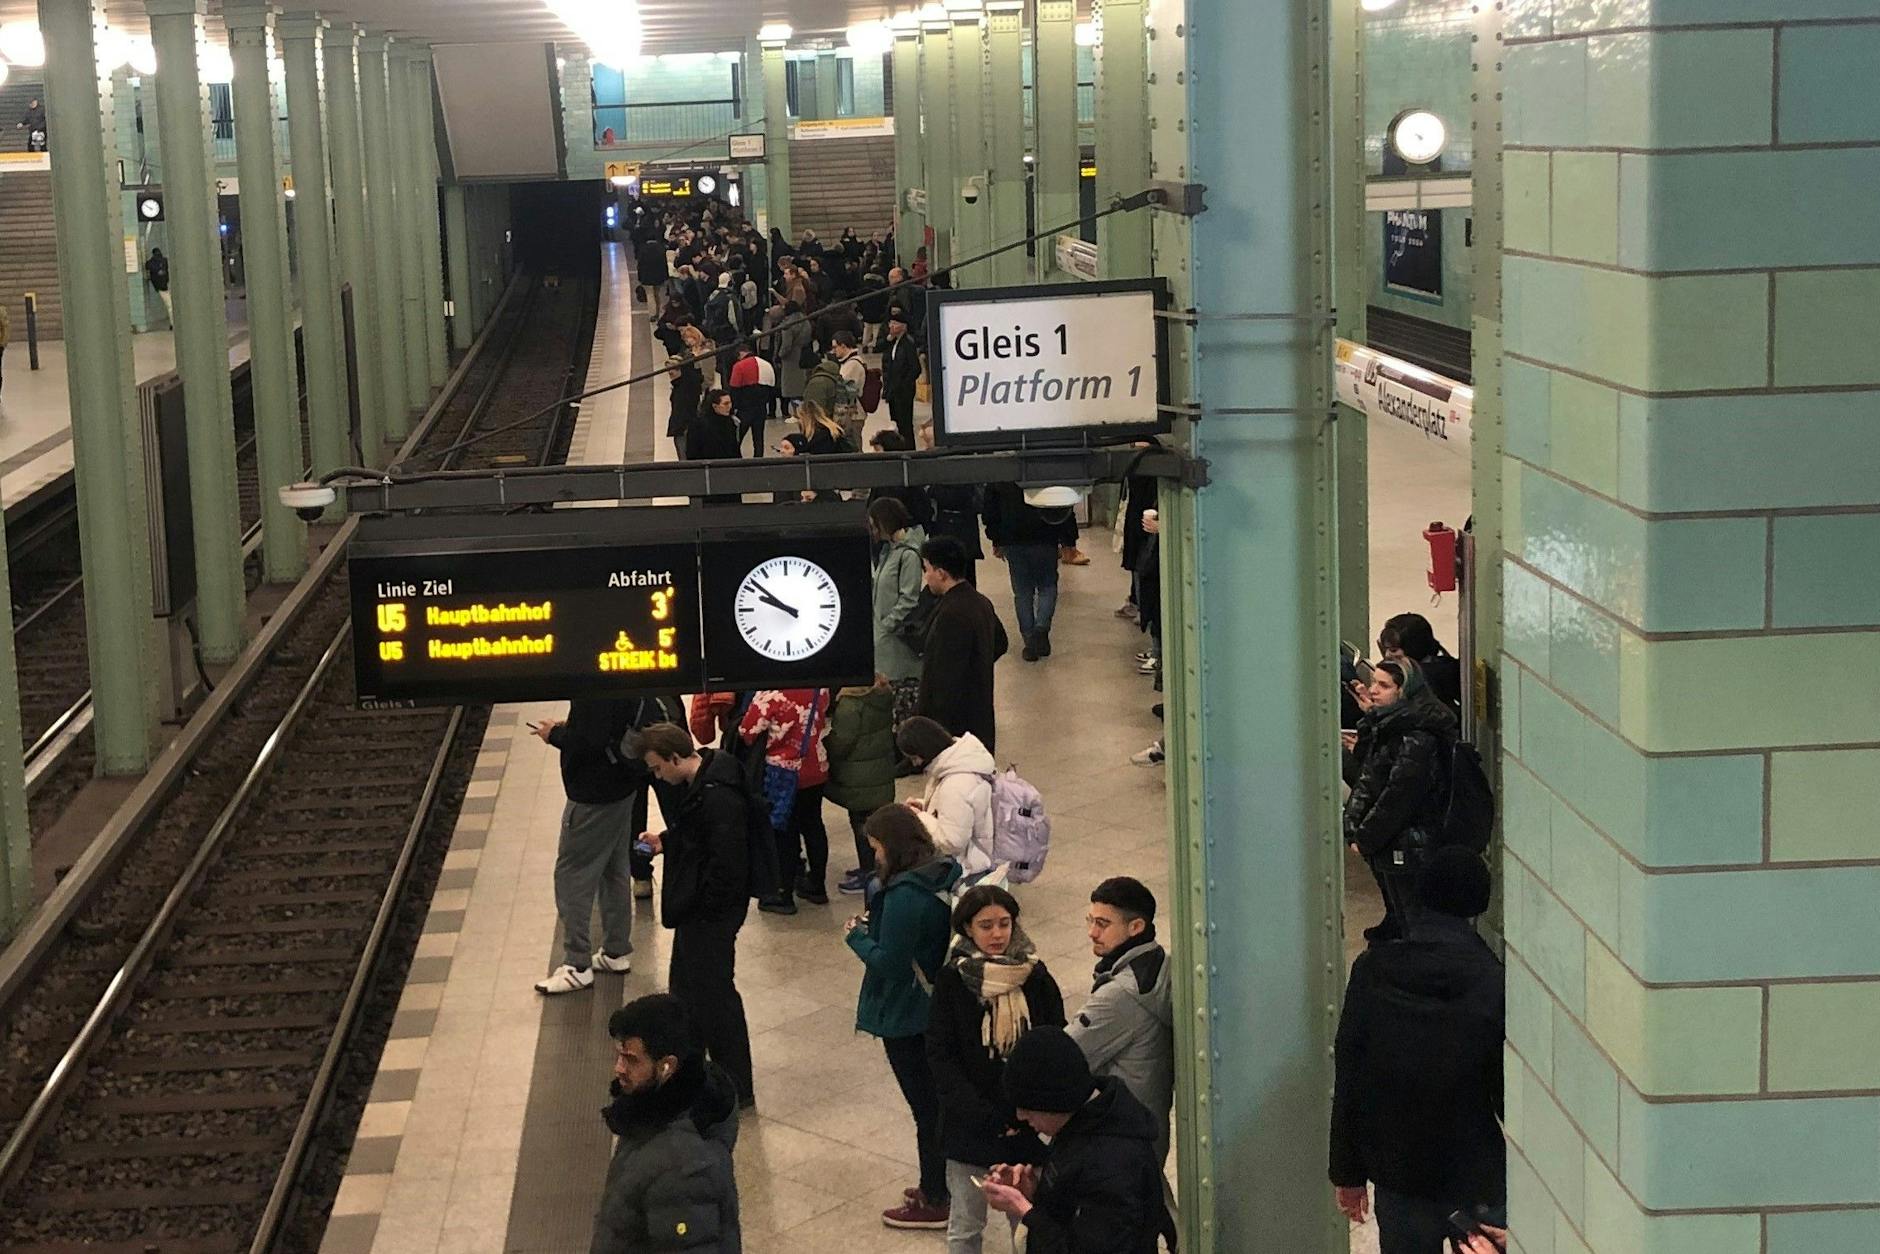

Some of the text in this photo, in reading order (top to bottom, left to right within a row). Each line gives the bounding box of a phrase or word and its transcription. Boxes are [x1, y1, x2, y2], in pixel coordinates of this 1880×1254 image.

[954, 323, 1067, 361] Gleis 1
[957, 365, 1142, 407] Platform 1
[377, 579, 453, 598] Linie Ziel
[607, 569, 672, 588] Abfahrt
[376, 601, 552, 632] U5 Hauptbahnhof
[378, 634, 554, 661] U5 Hauptbahnhof
[598, 650, 656, 671] STREIK
